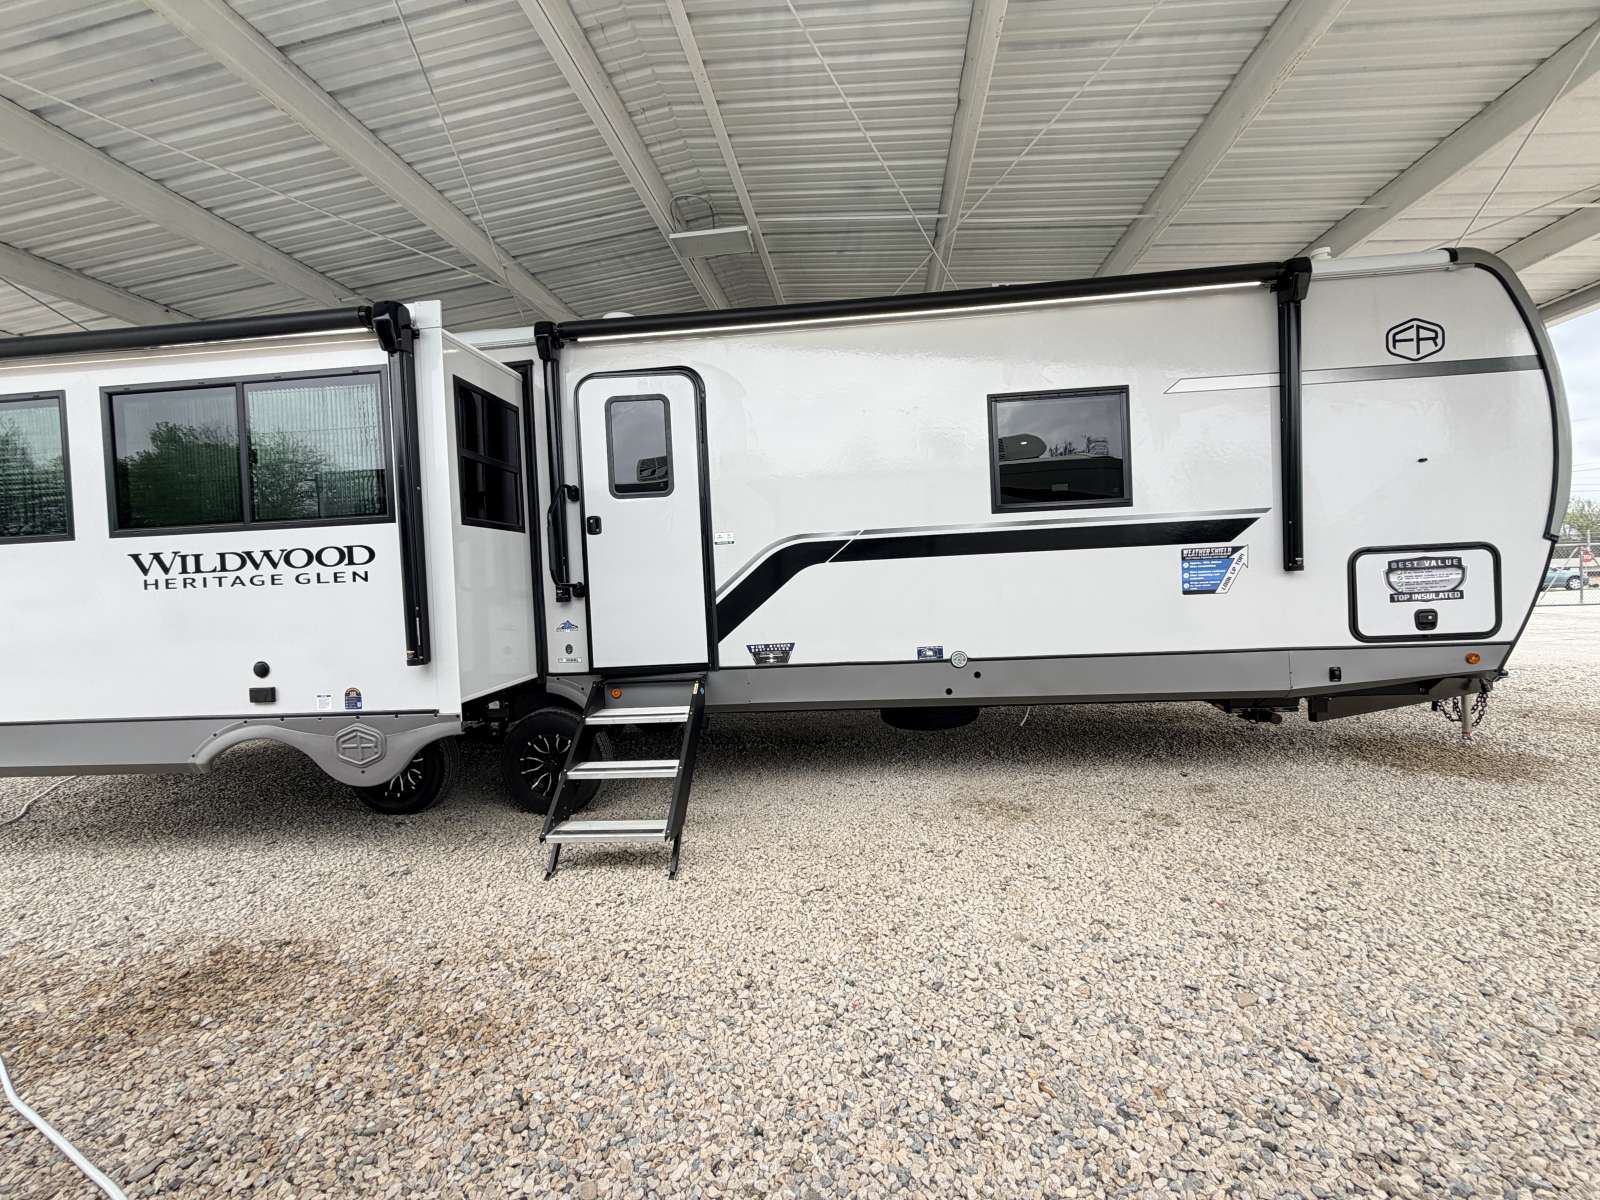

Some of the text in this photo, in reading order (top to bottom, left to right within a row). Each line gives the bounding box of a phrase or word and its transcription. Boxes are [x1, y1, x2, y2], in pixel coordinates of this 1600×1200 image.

[127, 544, 376, 576] WILDWOOD
[1390, 558, 1460, 570] BEST VALUE
[143, 570, 370, 590] HERITAGE GLEN
[1393, 591, 1461, 602] TOP INSULATED
